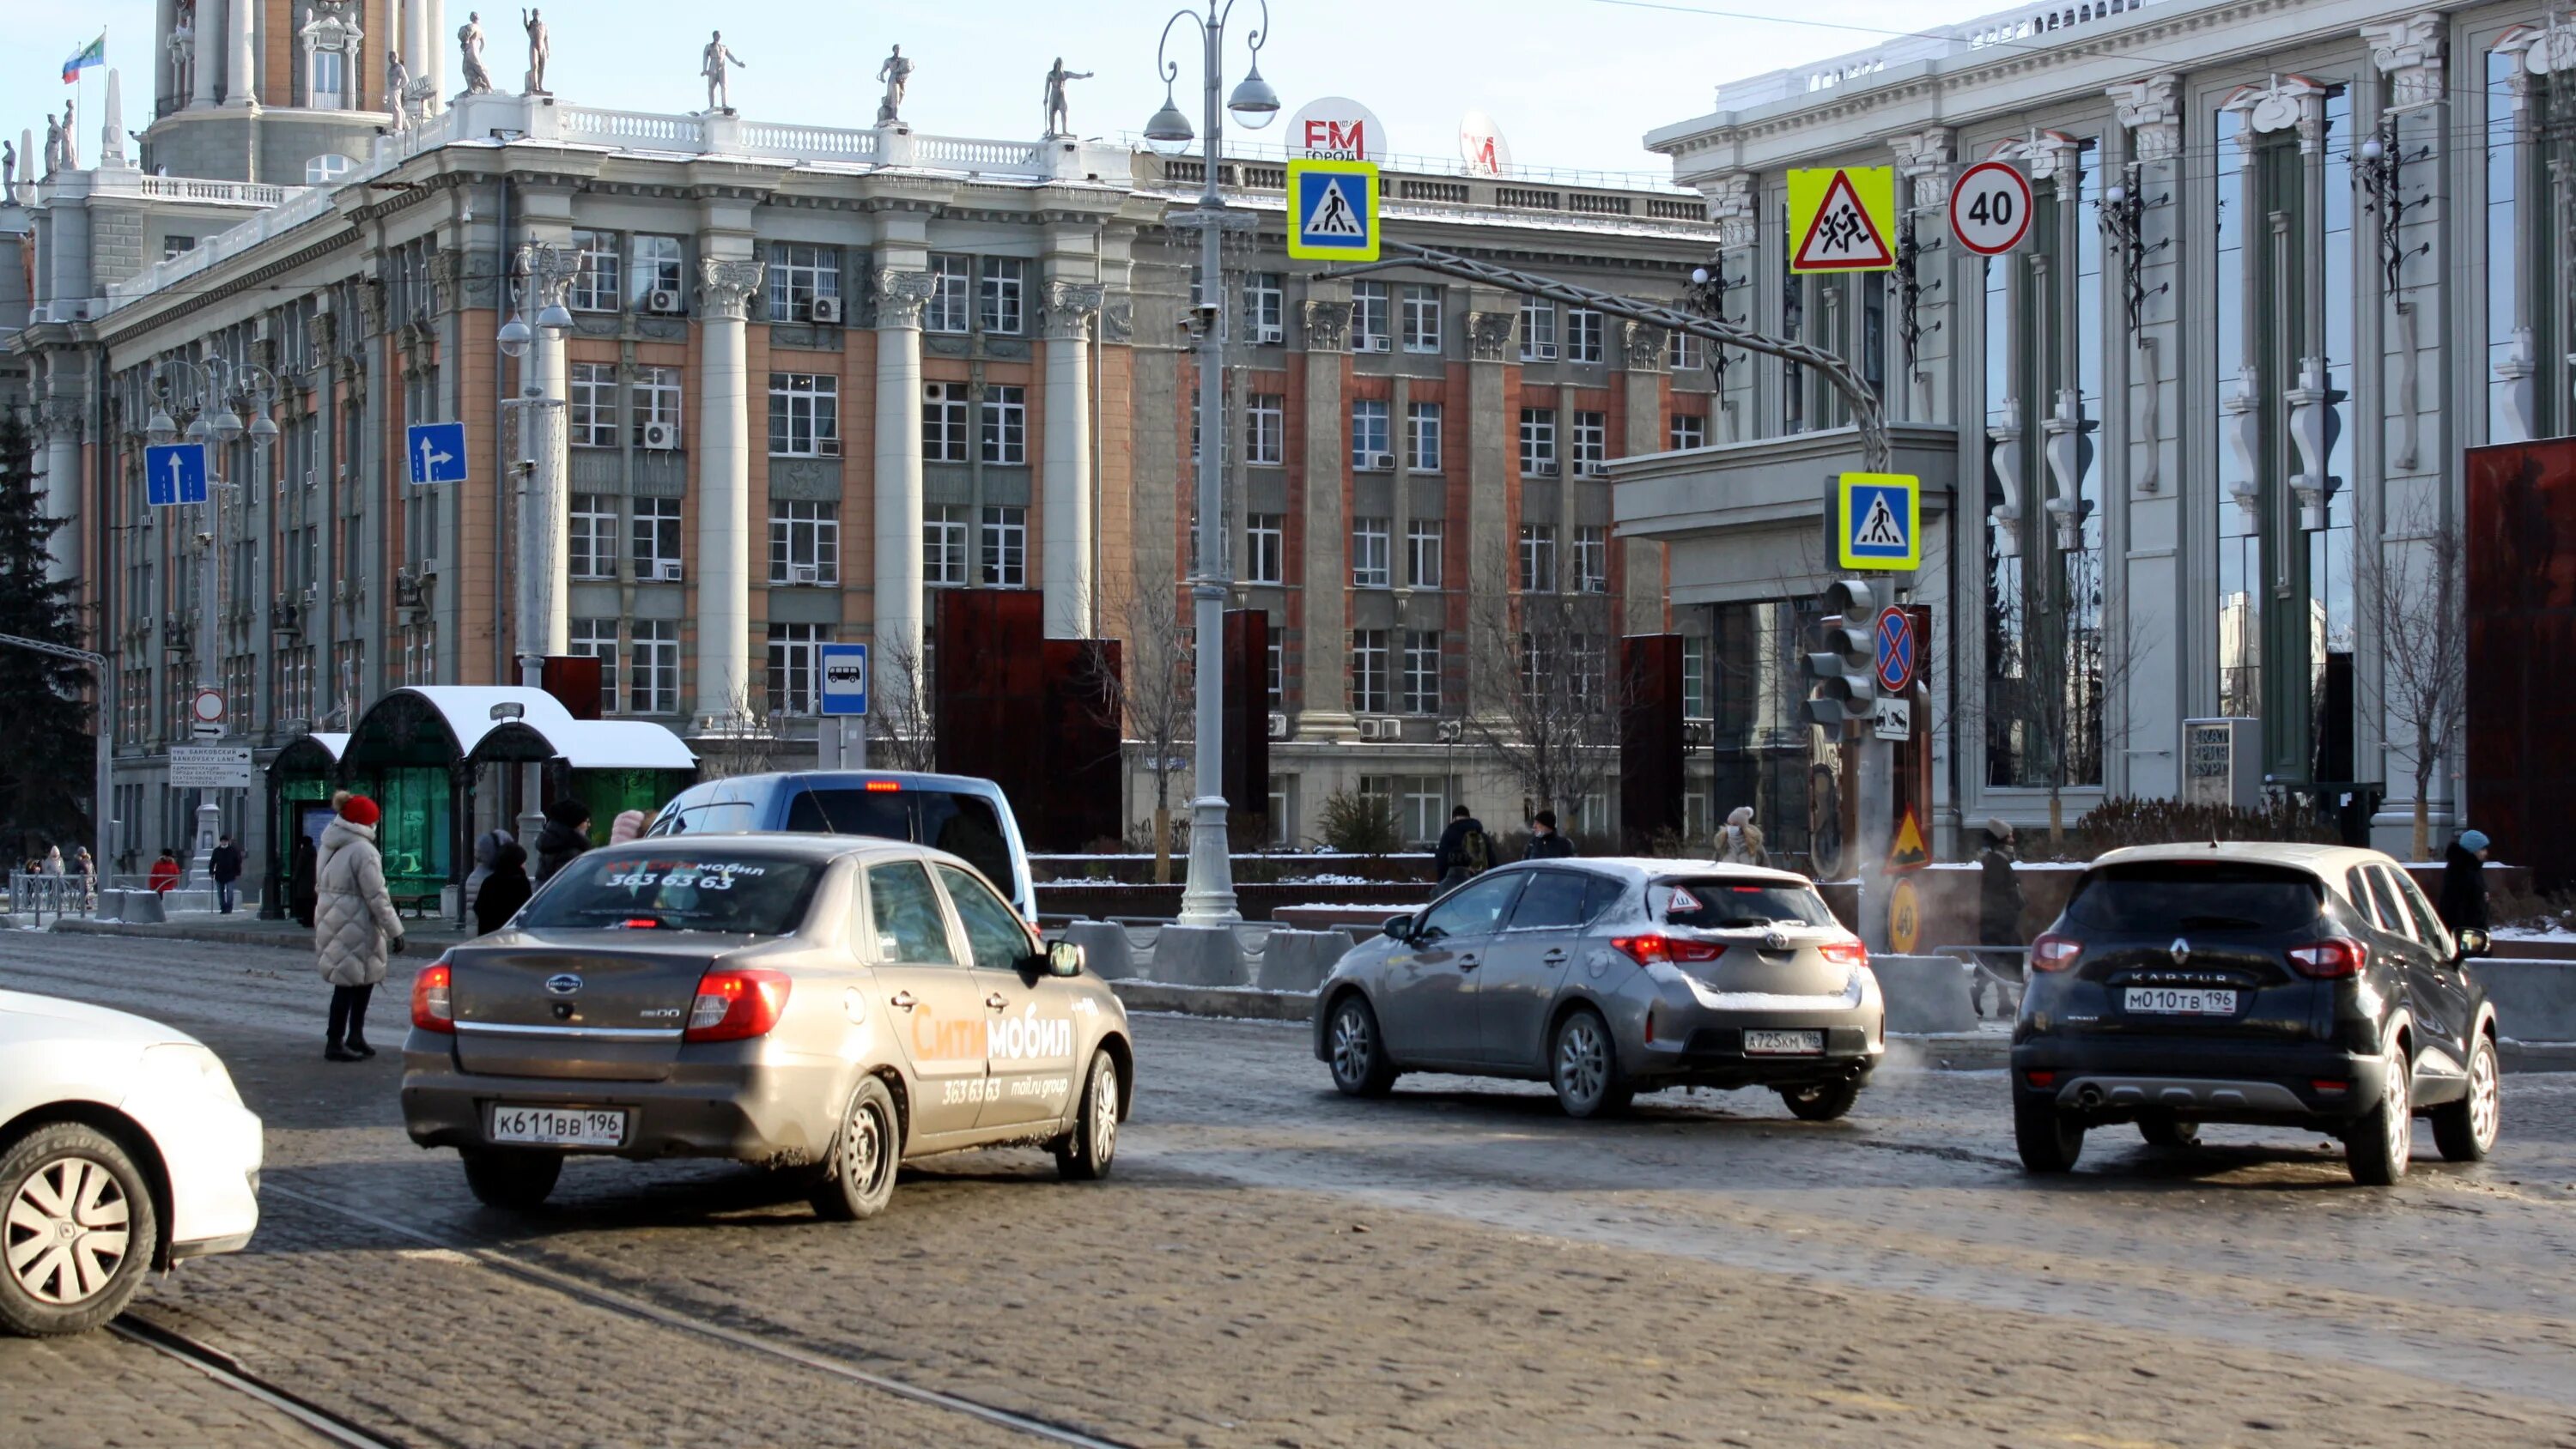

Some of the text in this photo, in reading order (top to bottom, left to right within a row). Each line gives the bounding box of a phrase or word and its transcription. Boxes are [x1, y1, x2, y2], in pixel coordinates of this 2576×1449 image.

[1304, 118, 1364, 160] FM
[1305, 150, 1355, 161] ГОРОД
[1968, 191, 2013, 226] 40
[605, 873, 737, 890] 363 63 63
[2129, 991, 2233, 1009] М010ТВ 196
[912, 1002, 1071, 1060] Ситимобил
[942, 1077, 1002, 1106] 363 63 63
[1011, 1076, 1068, 1100] mail.ru group
[500, 1111, 617, 1137] К611ВВ 196
